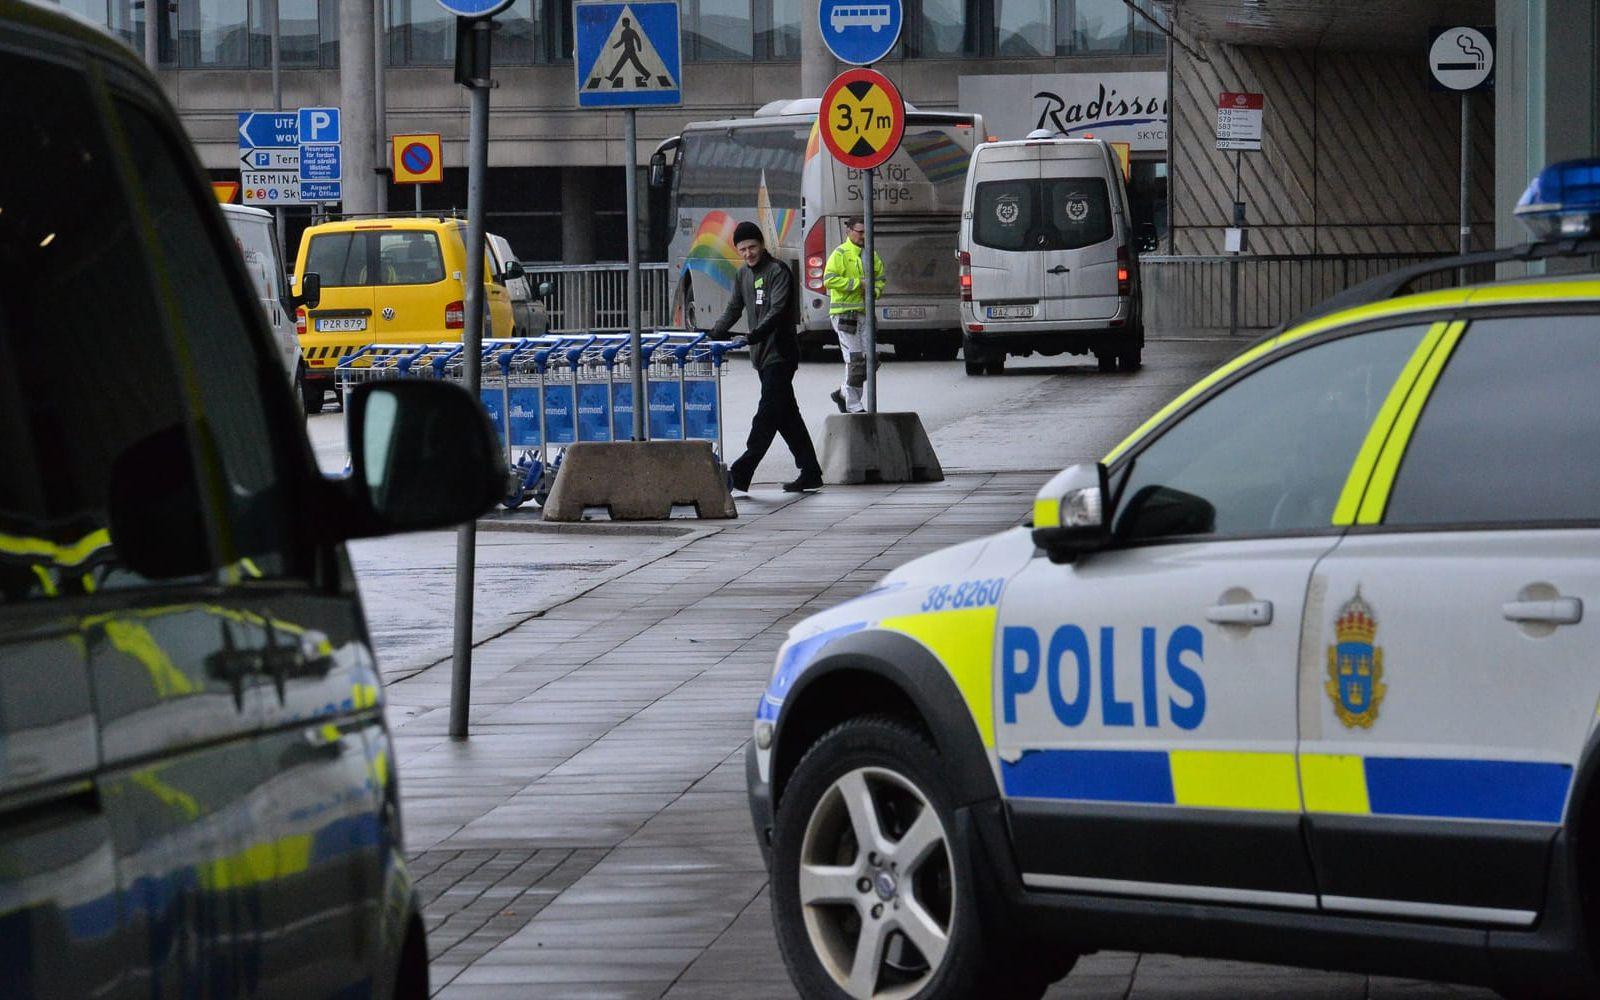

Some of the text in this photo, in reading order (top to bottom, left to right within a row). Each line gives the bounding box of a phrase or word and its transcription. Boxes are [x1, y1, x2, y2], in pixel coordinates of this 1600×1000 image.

[887, 163, 910, 180] för
[323, 319, 363, 329] PZR 879
[922, 577, 1004, 612] 38-8260
[1002, 624, 1207, 731] POLIS
